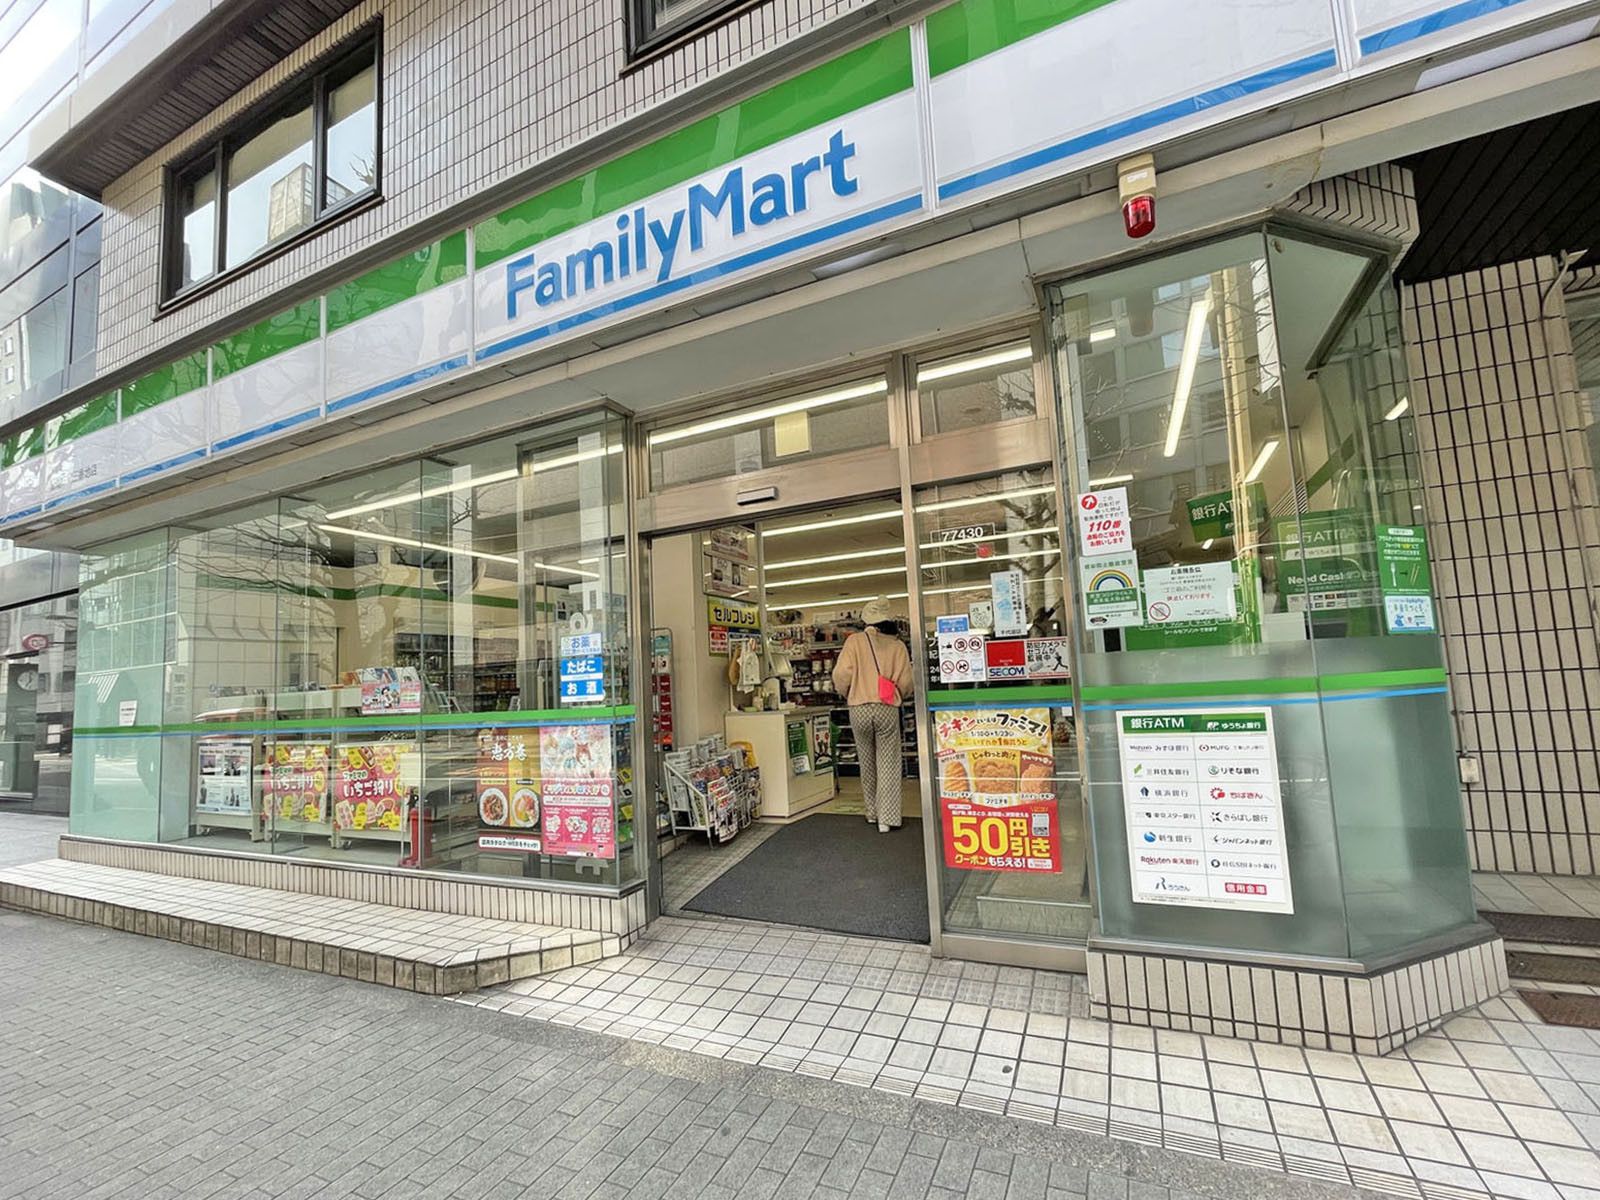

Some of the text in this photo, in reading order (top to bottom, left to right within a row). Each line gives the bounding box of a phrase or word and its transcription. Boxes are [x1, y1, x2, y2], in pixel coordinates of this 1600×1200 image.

[507, 128, 858, 320] FamilyMart
[1089, 520, 1122, 532] 110番
[941, 526, 984, 542] 77430
[713, 606, 756, 625] セルフレジ
[1027, 647, 1056, 656] セコムが
[567, 660, 596, 674] たばこ
[989, 667, 1025, 677] SECOM
[1131, 717, 1185, 729] 銀行ATM
[1221, 721, 1261, 730] ゆうちょ銀行
[491, 743, 528, 761] 恵方巻
[1146, 768, 1190, 776] 三井住友銀行
[1221, 767, 1260, 775] りそな銀行
[343, 780, 394, 797] いちご狩り
[1154, 812, 1196, 820] 東京スター銀行
[1159, 834, 1192, 843] 新生銀行
[1222, 837, 1273, 846] ジャパンネット銀行
[954, 855, 1026, 869] クーポンもらえる!
[1141, 856, 1199, 866] Rakuten 楽天銀行
